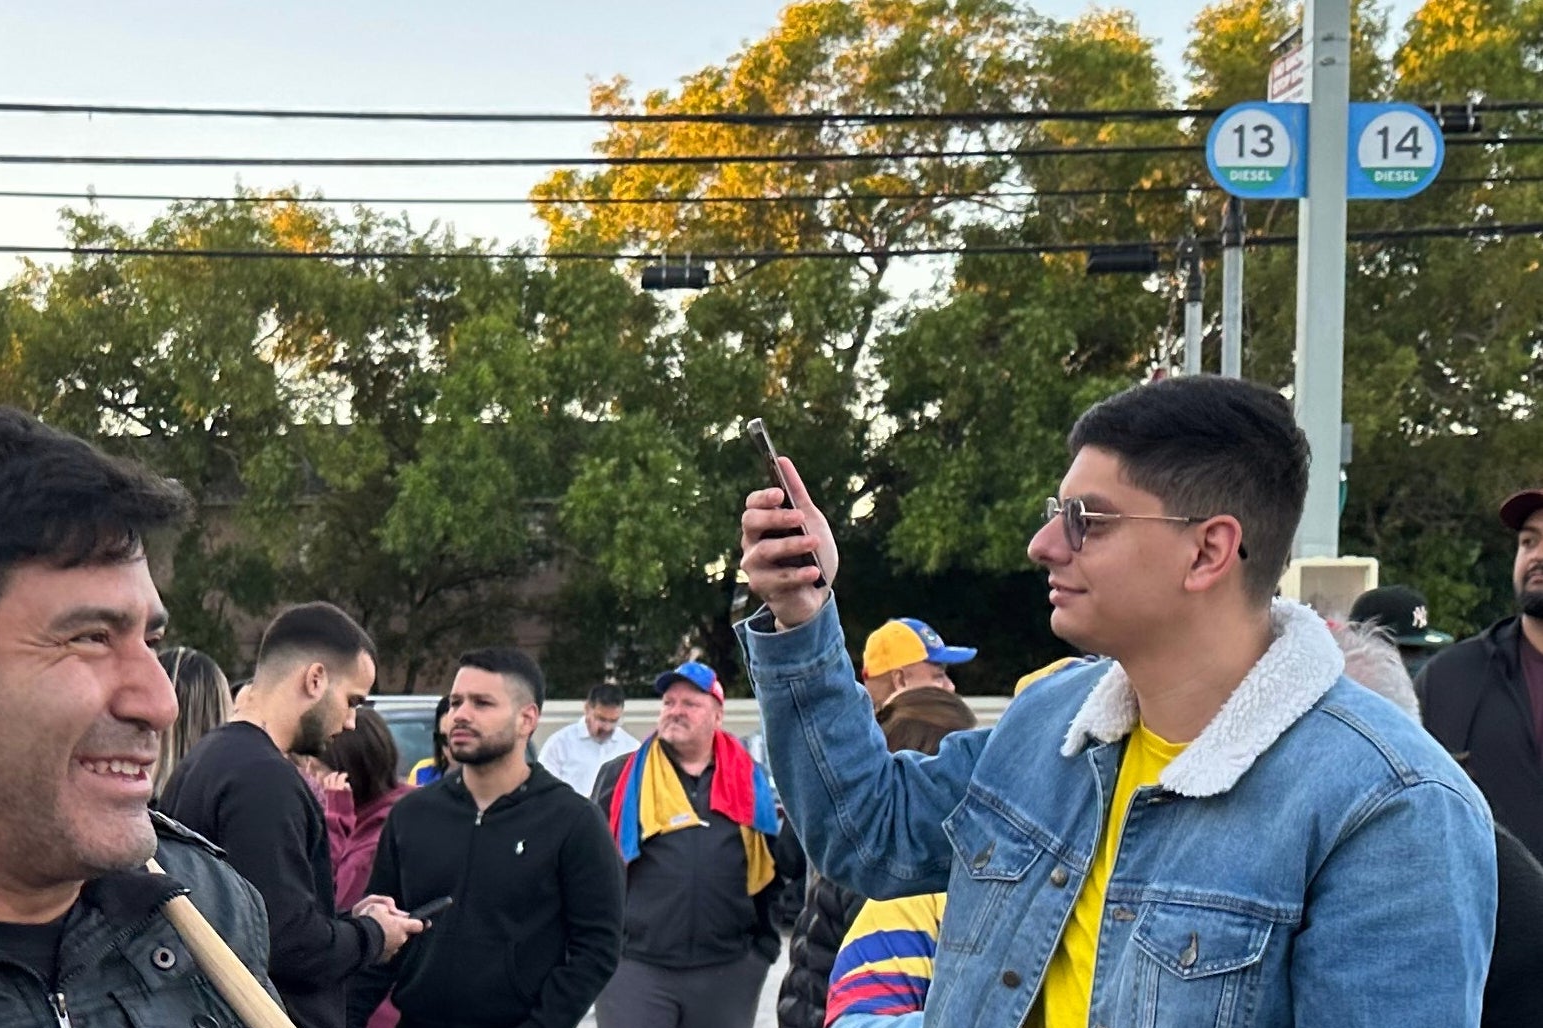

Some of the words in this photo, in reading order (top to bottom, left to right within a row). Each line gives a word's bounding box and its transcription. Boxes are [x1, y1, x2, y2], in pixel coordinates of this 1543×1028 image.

[1233, 124, 1274, 158] 13
[1376, 126, 1422, 160] 14
[1229, 170, 1273, 181] DIESEL
[1374, 170, 1419, 182] DIESEL
